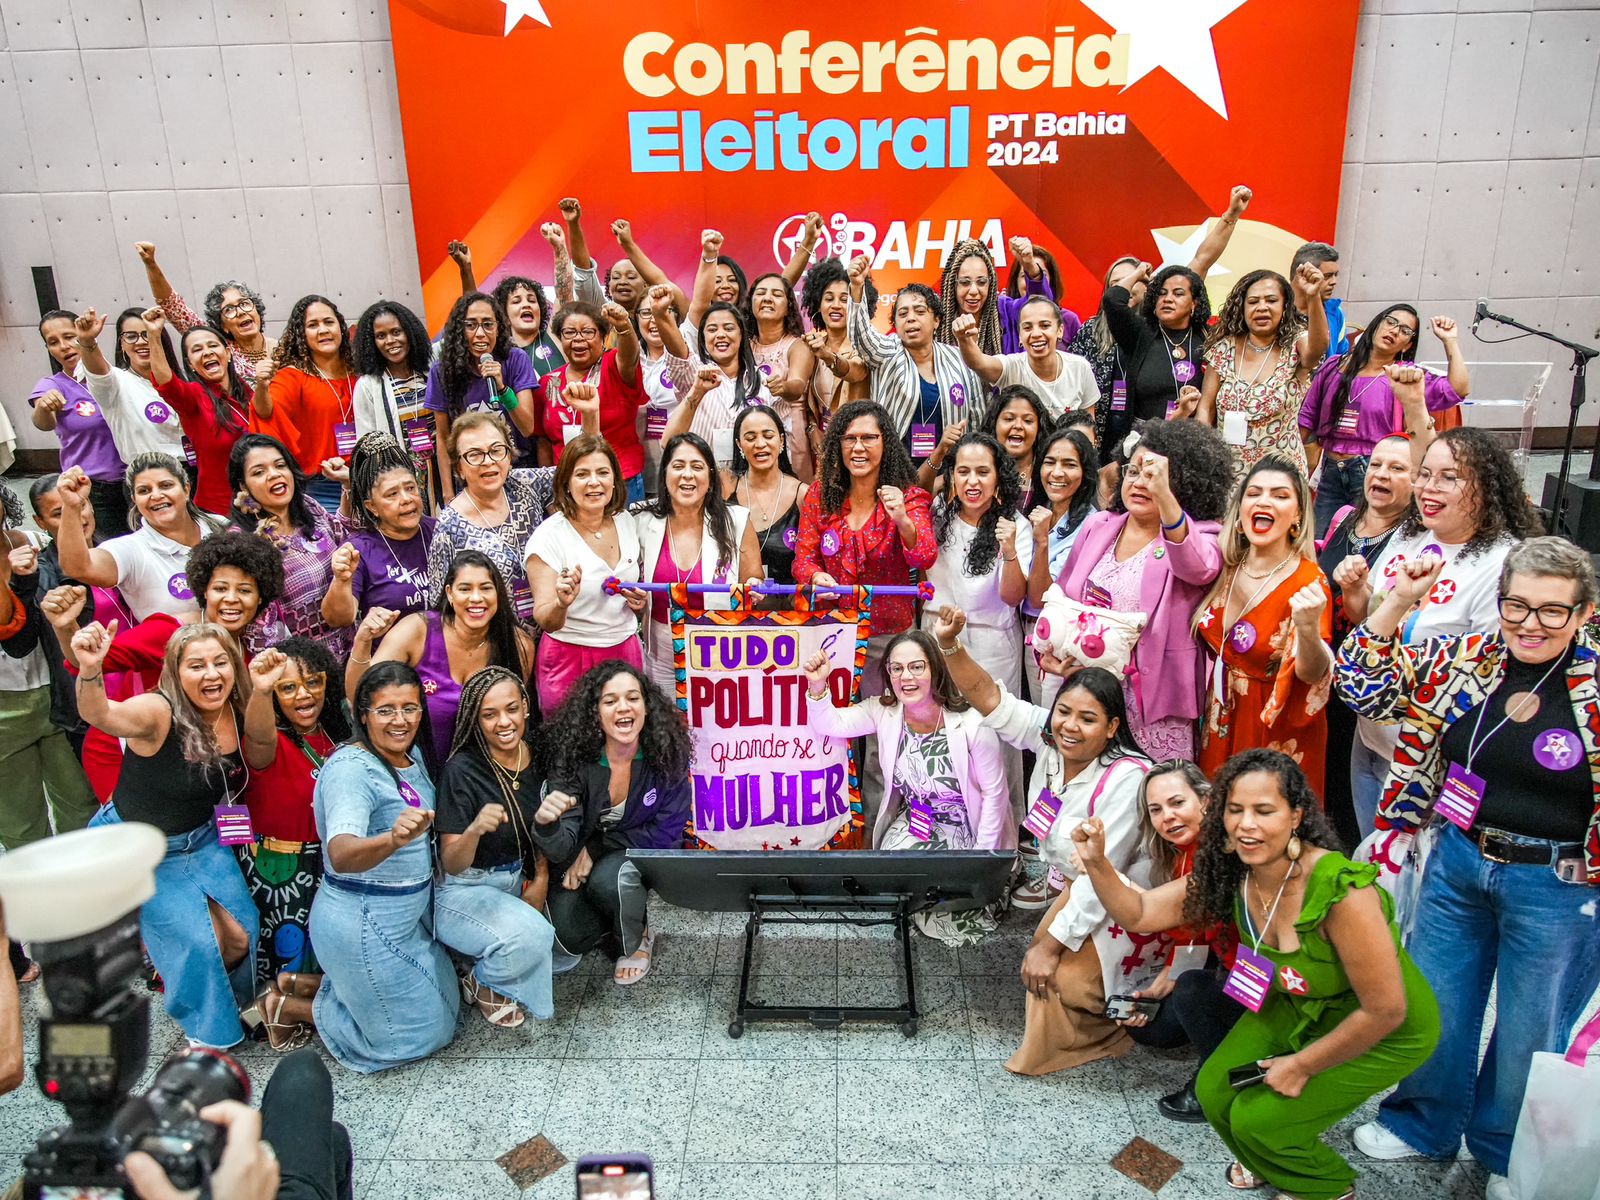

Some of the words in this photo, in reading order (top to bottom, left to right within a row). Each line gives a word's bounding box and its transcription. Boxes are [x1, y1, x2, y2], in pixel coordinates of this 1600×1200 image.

[622, 25, 1131, 98] Conferência
[628, 105, 971, 173] Eleitoral
[986, 113, 1029, 139] PT
[1033, 110, 1127, 138] Bahia
[986, 140, 1059, 167] 2024
[842, 218, 1008, 270] BAHIA
[694, 634, 796, 669] TUDO
[690, 663, 853, 729] POLÍTIO
[710, 733, 790, 774] quando
[791, 736, 816, 760] se
[692, 762, 850, 832] MULHER
